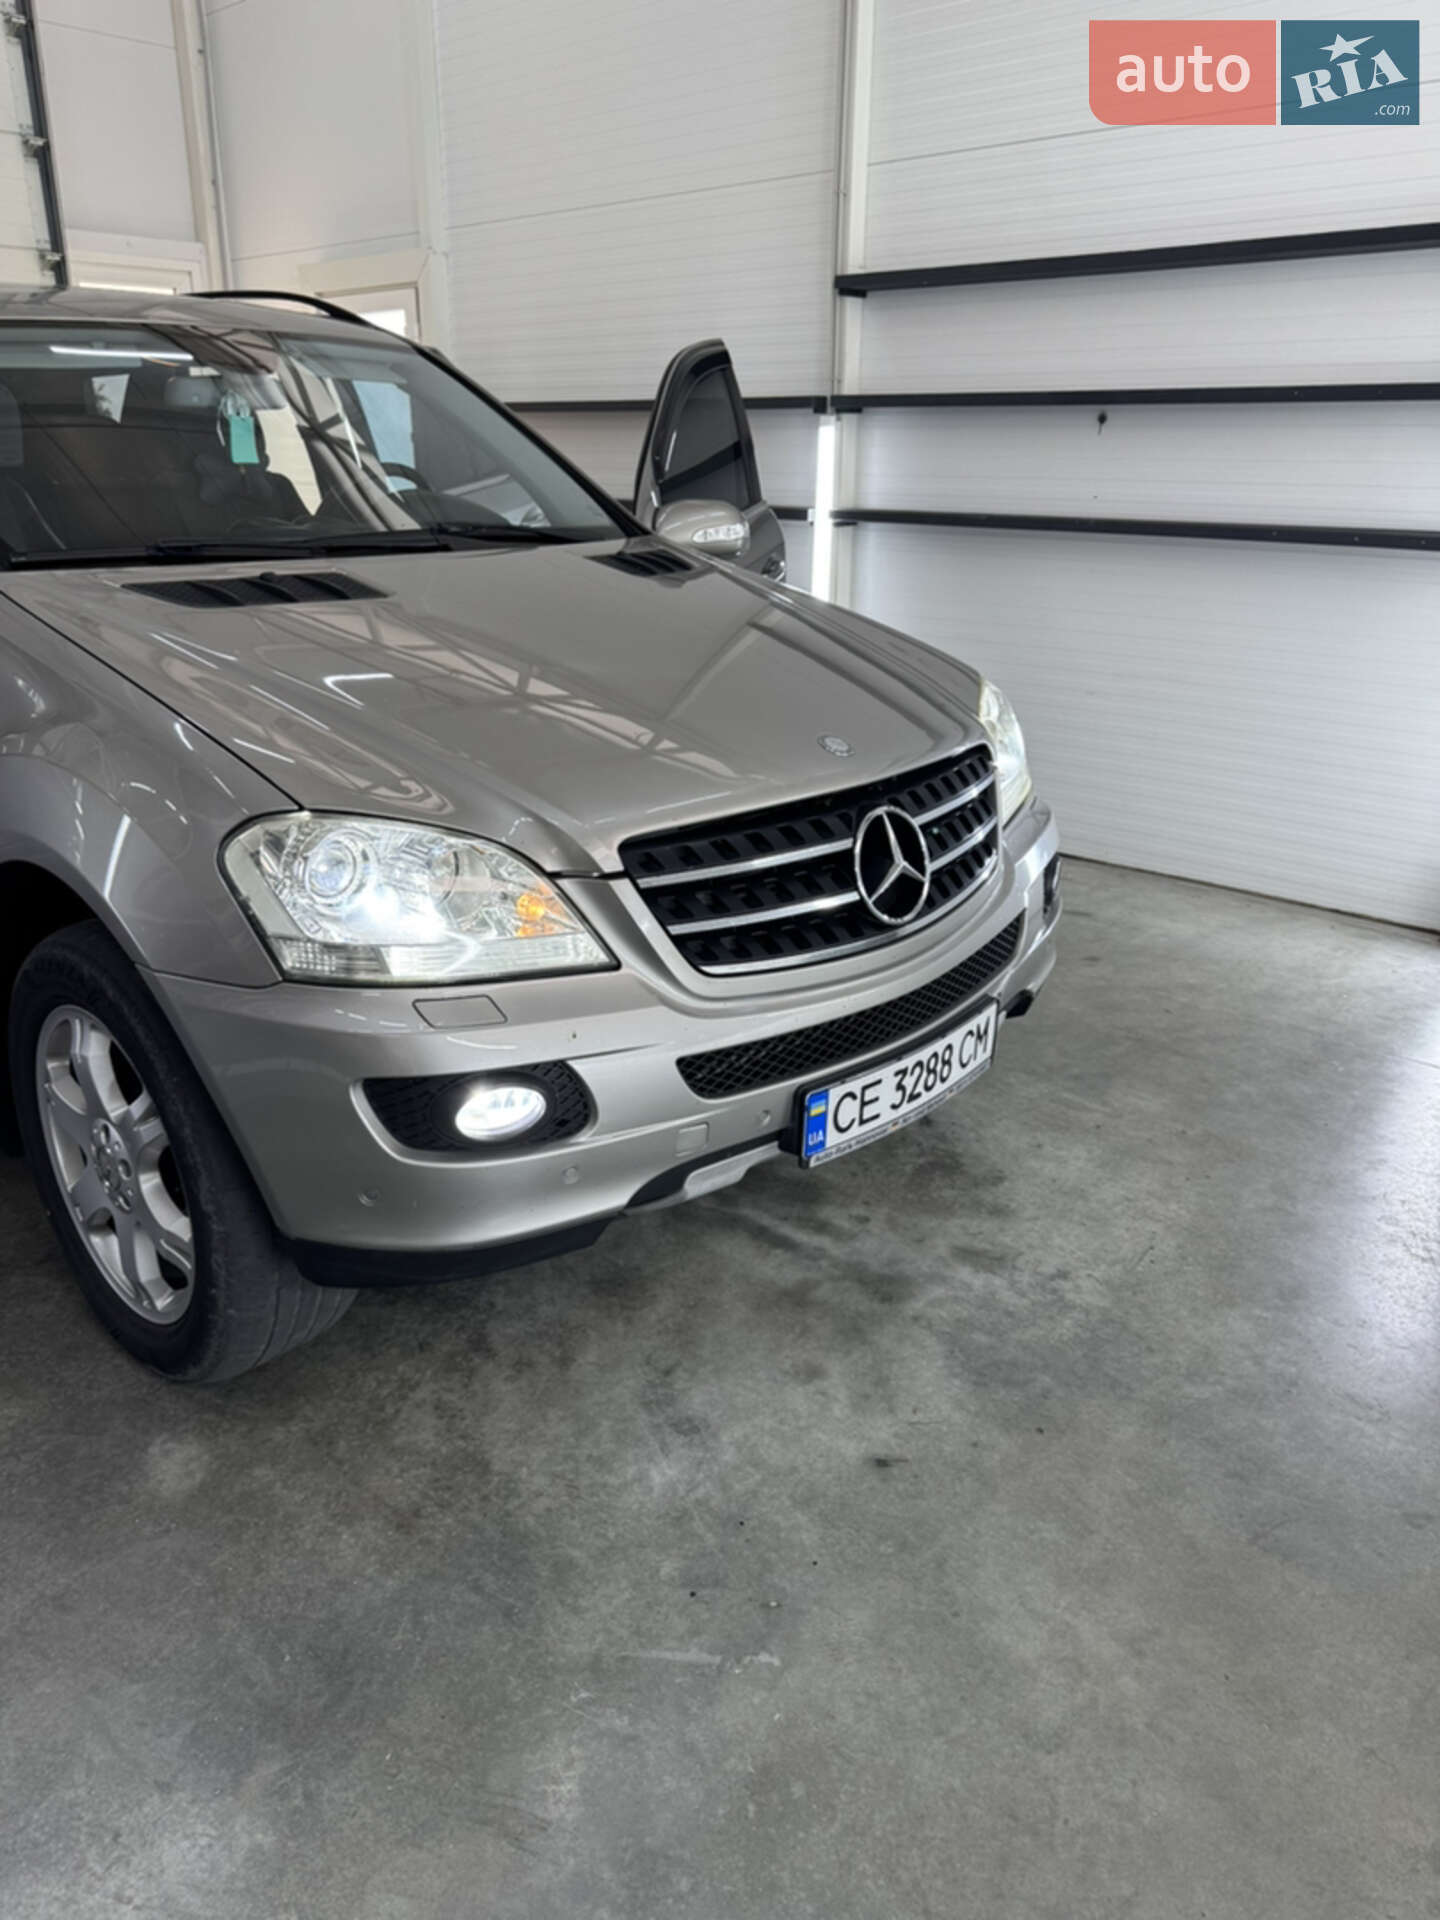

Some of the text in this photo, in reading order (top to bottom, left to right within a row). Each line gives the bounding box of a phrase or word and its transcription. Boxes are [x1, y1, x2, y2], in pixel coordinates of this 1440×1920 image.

[833, 1079, 883, 1133] CE
[890, 1043, 953, 1110] 3288
[958, 1017, 990, 1069] CM
[808, 1130, 824, 1146] UA
